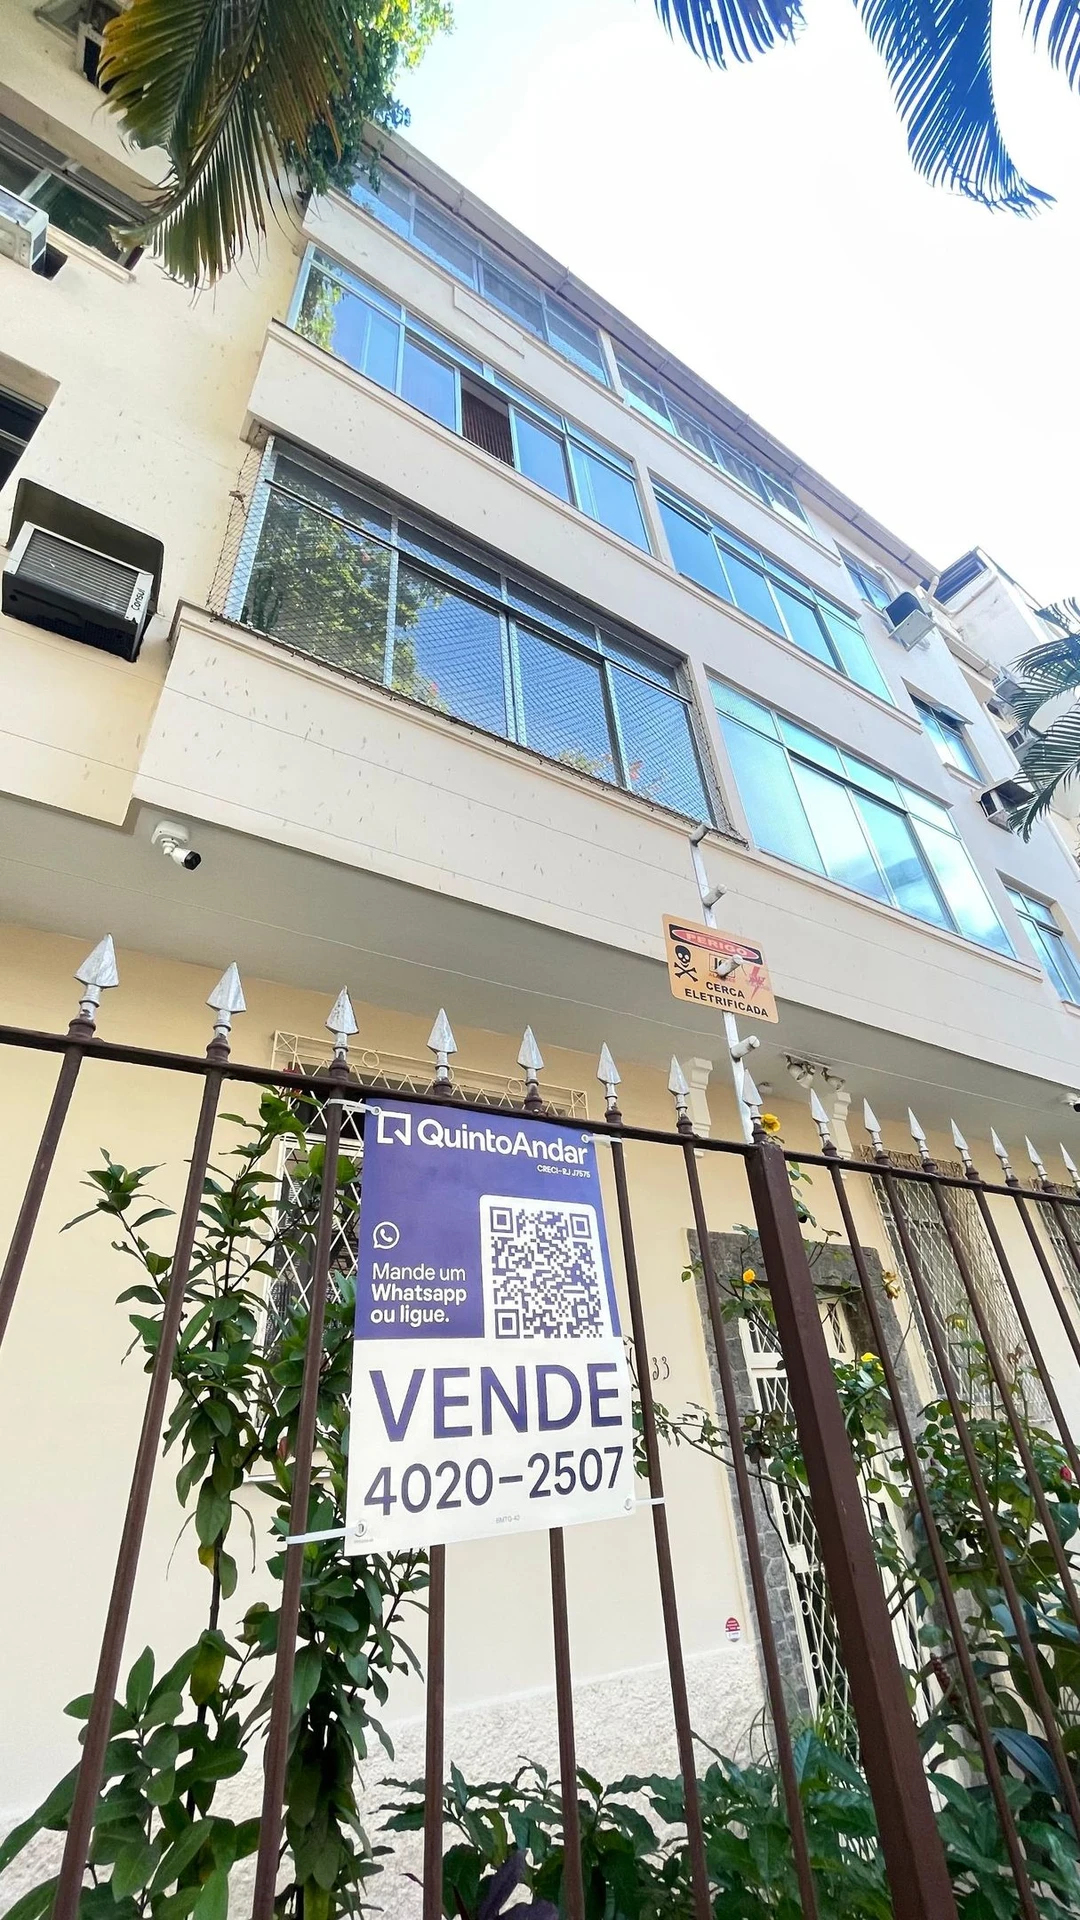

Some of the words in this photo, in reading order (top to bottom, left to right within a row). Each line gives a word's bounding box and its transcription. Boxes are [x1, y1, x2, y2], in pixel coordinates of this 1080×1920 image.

[686, 933, 748, 956] PERIGO
[705, 981, 746, 999] CERCA
[684, 988, 769, 1017] ELETRIFICADA
[417, 1118, 589, 1165] QuintoAndar
[372, 1262, 436, 1281] Mande
[439, 1267, 466, 1281] um
[371, 1283, 467, 1306] Whatsapp
[370, 1308, 396, 1323] ou
[399, 1304, 450, 1328] ligue.
[369, 1362, 623, 1442] VENDE
[363, 1446, 624, 1516] 4020-2507
